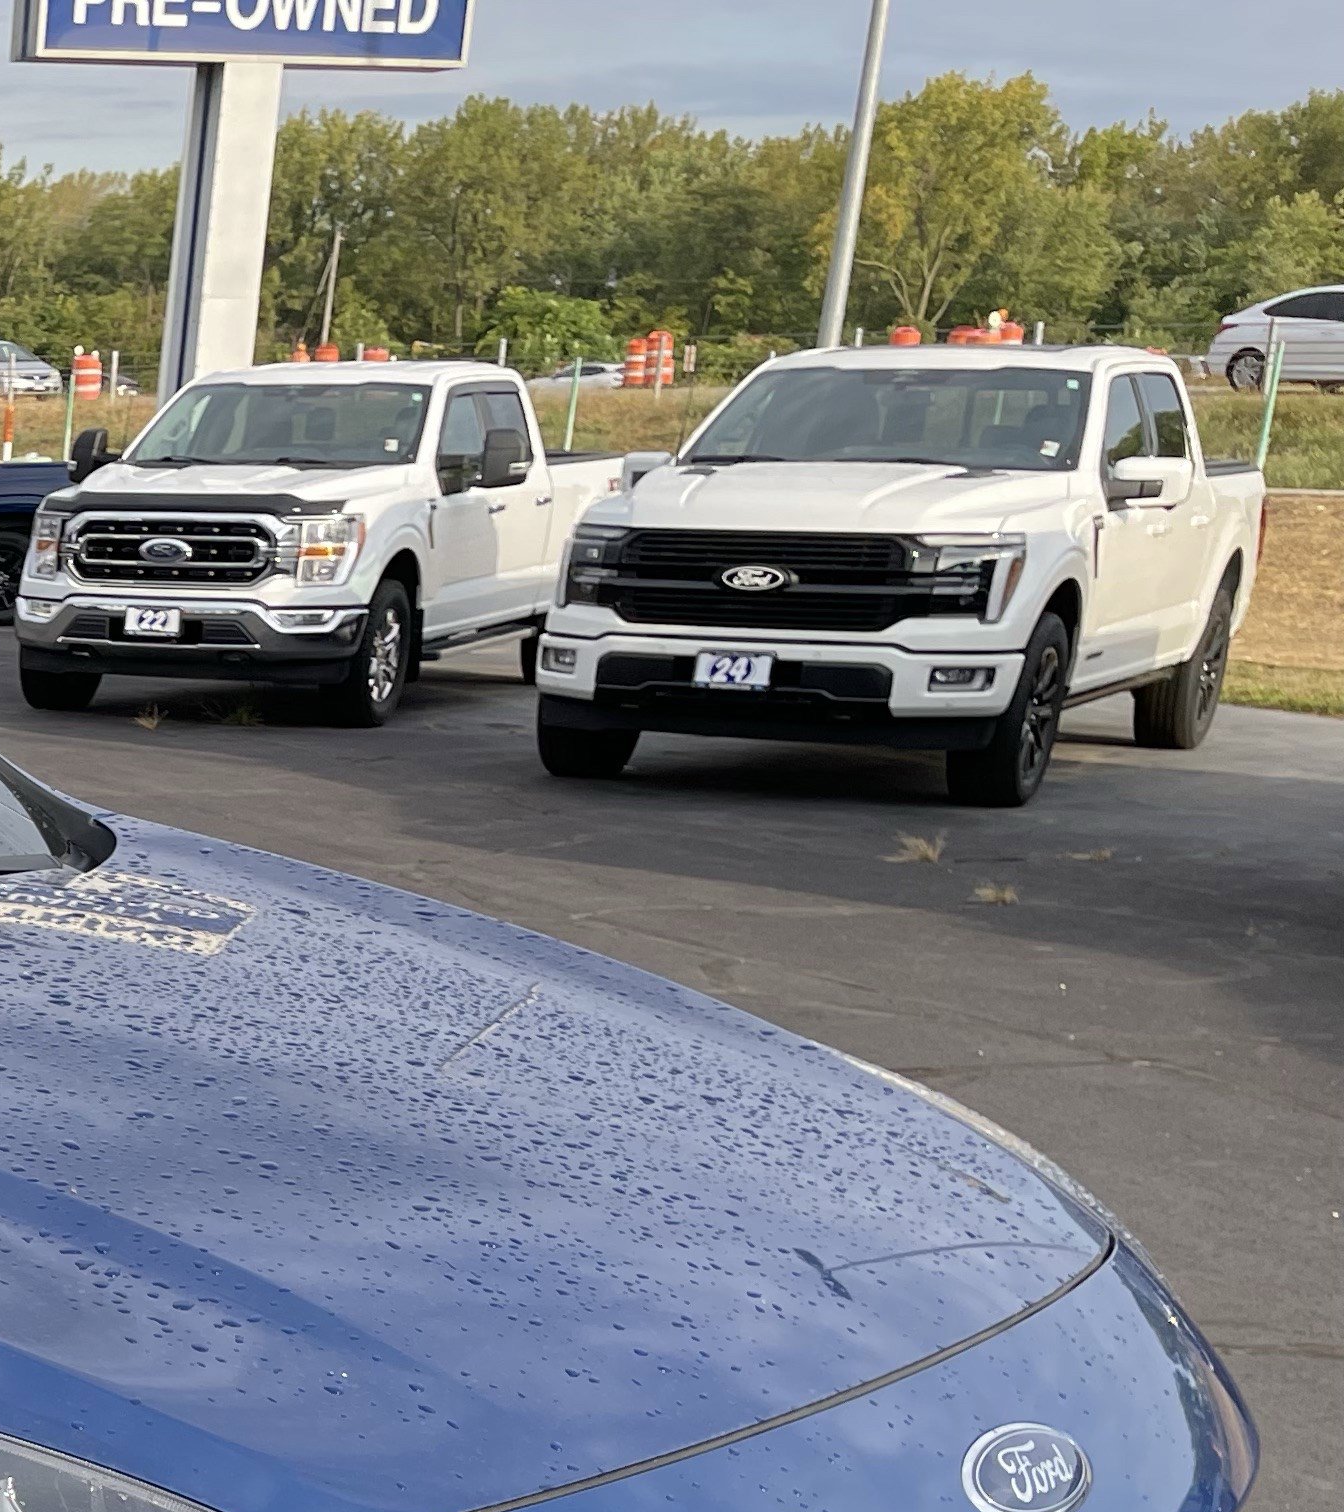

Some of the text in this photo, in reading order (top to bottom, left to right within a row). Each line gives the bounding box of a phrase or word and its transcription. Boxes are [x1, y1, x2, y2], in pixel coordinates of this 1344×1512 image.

[140, 609, 167, 631] 22
[712, 656, 749, 683] 24
[996, 1439, 1075, 1503] Ford
